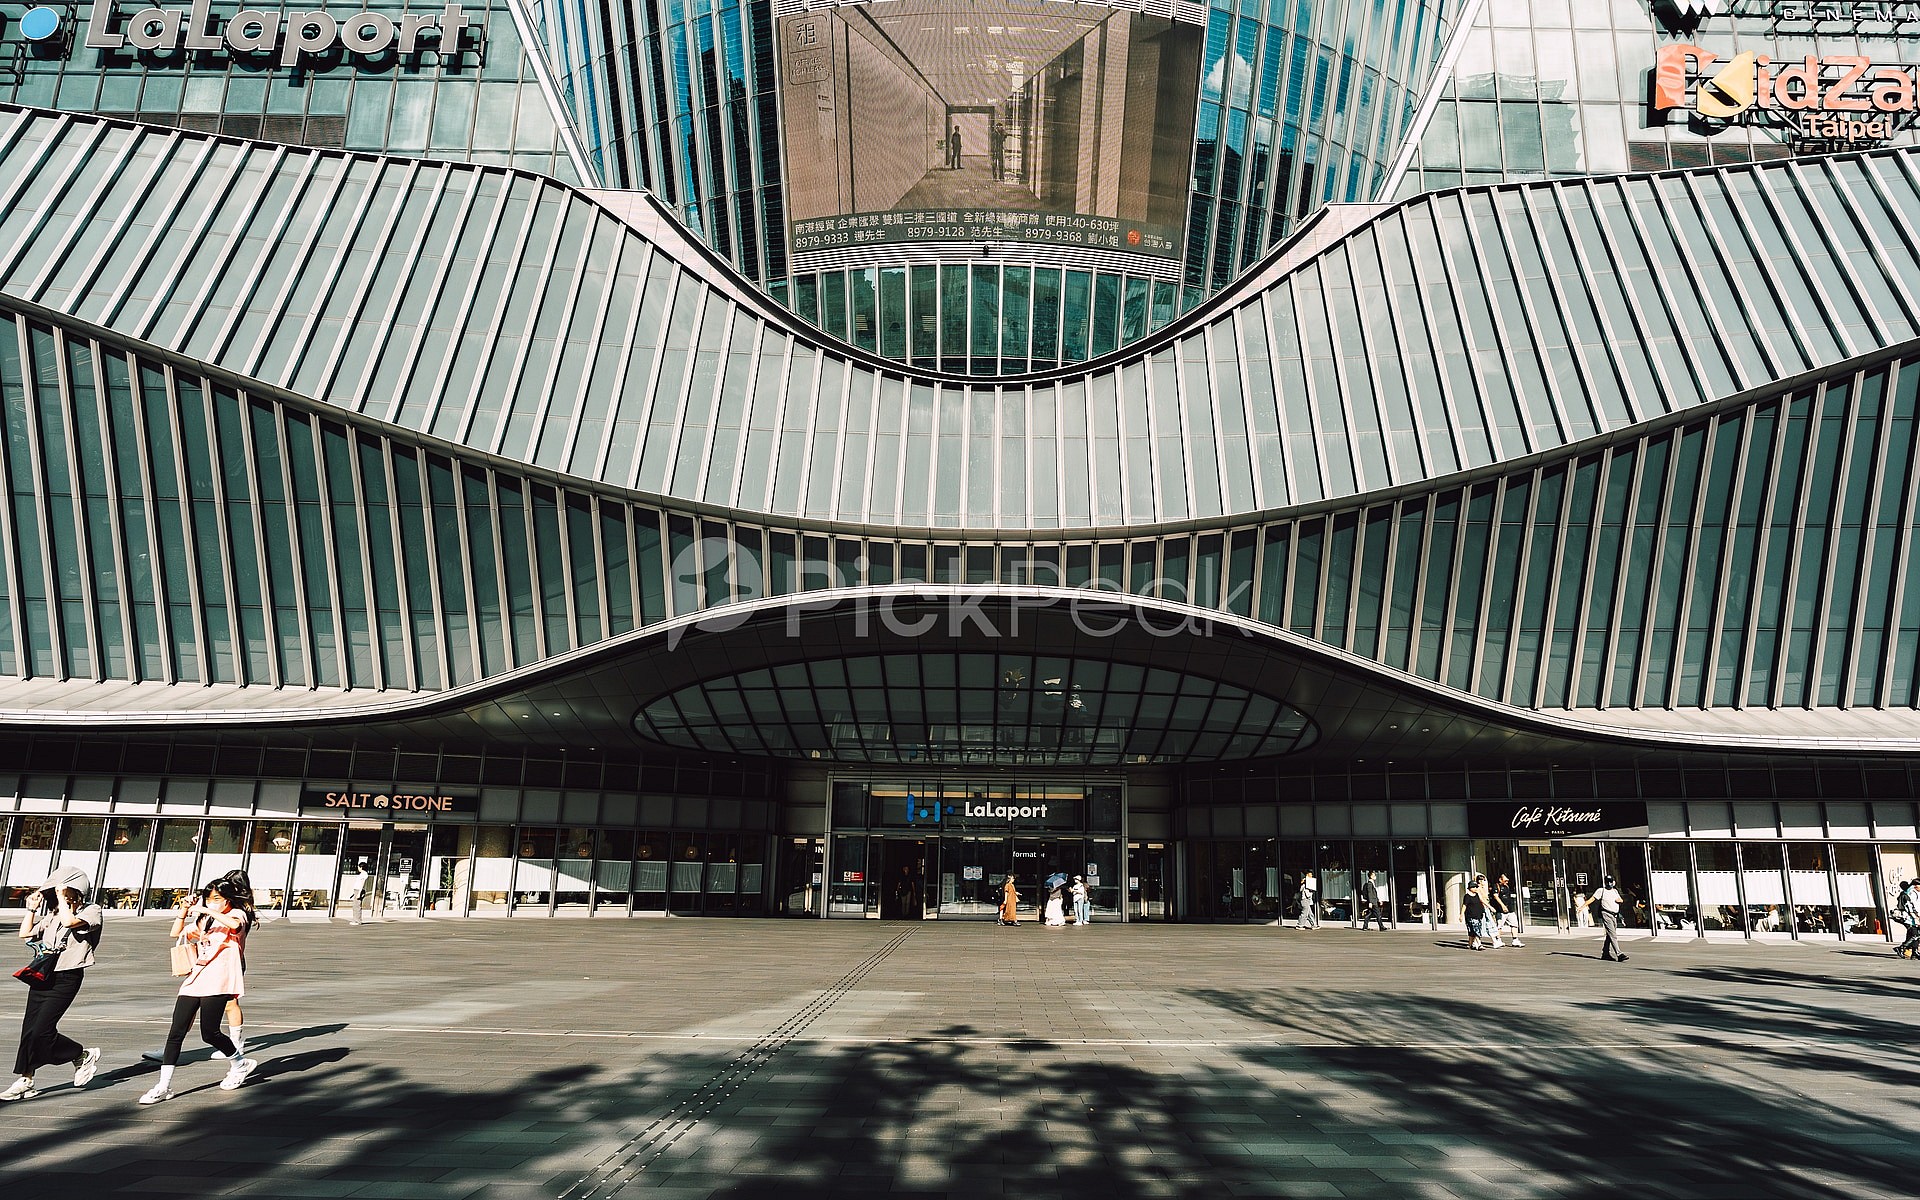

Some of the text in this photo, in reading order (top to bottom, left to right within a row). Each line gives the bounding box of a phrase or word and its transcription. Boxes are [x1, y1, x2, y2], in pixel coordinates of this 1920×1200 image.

[85, 0, 470, 66] LaLaport
[796, 22, 817, 46] 租
[1655, 44, 1920, 117] KidZa
[1805, 114, 1892, 142] Taipei
[795, 233, 849, 248] 8979-9333
[908, 227, 965, 238] 8979-9128
[970, 226, 1004, 238] 范先生
[1025, 229, 1082, 243] 8979-9368
[325, 793, 453, 811] SALT STONE
[965, 801, 1048, 821] LaLaport
[1511, 806, 1602, 829] Café Kitsuné
